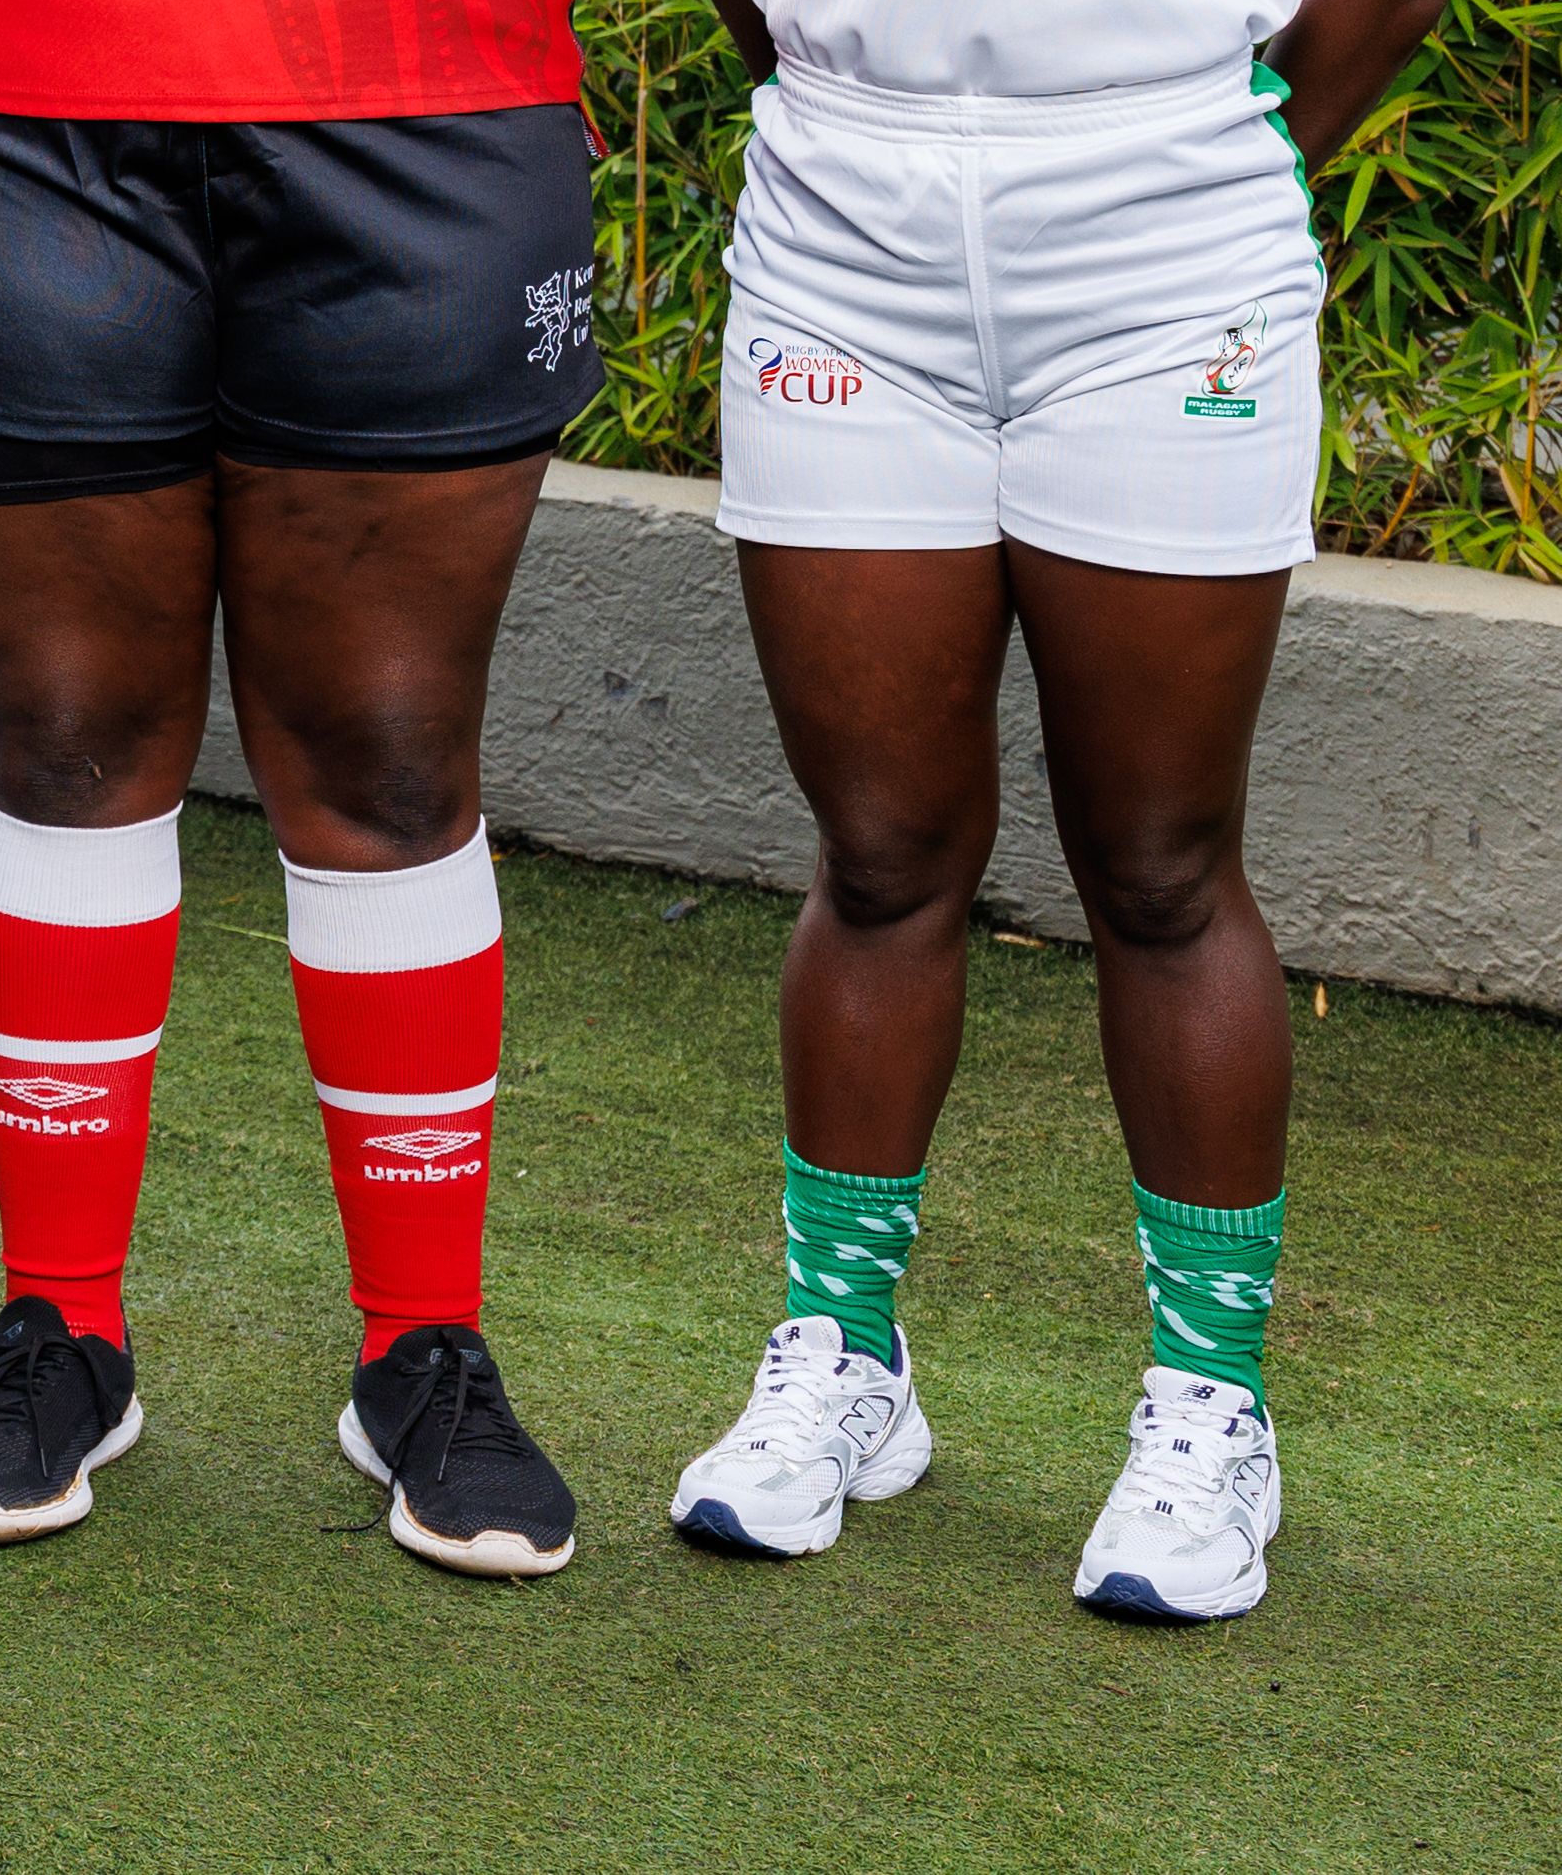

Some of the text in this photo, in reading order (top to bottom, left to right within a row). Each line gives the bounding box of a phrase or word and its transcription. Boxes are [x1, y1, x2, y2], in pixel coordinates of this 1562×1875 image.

[785, 345, 820, 356] RUGBY
[785, 357, 862, 375] WOMEN'S
[781, 372, 863, 406] CUP
[1187, 400, 1253, 410] MALAGASY
[1200, 408, 1242, 416] RUGBY
[364, 1157, 483, 1183] umbro
